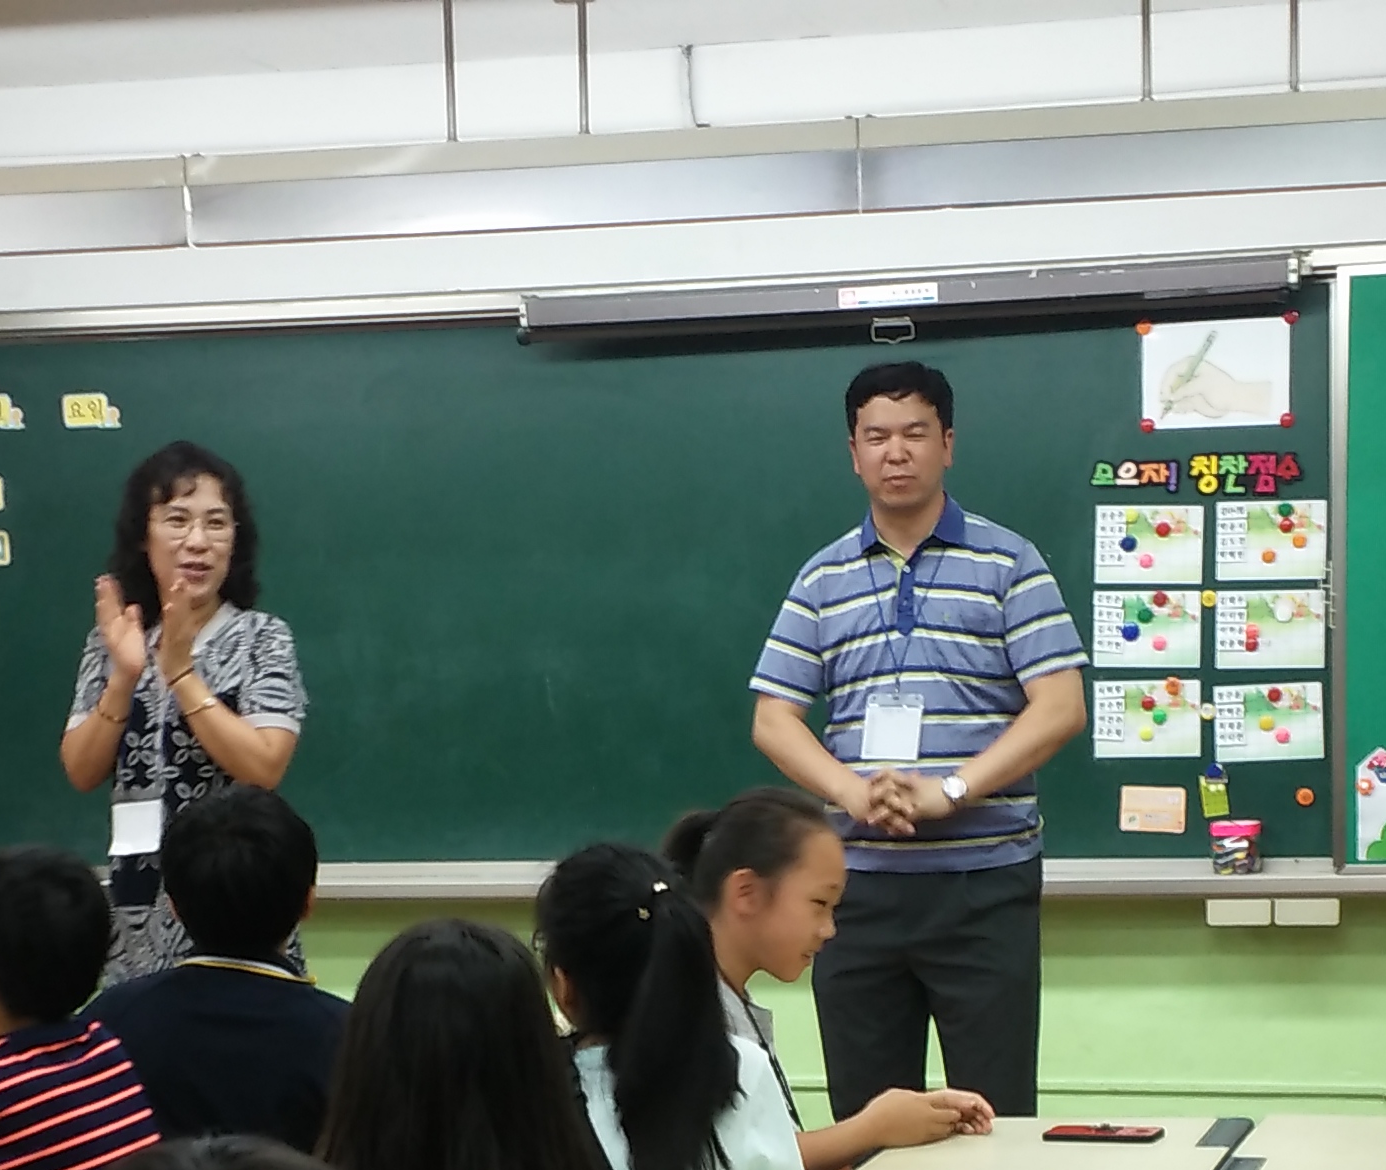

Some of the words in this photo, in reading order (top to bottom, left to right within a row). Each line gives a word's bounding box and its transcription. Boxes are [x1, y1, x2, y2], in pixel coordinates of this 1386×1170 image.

[68, 398, 105, 421] 요일
[1090, 459, 1179, 493] 모으자!
[1188, 453, 1301, 494] 칭찬점수
